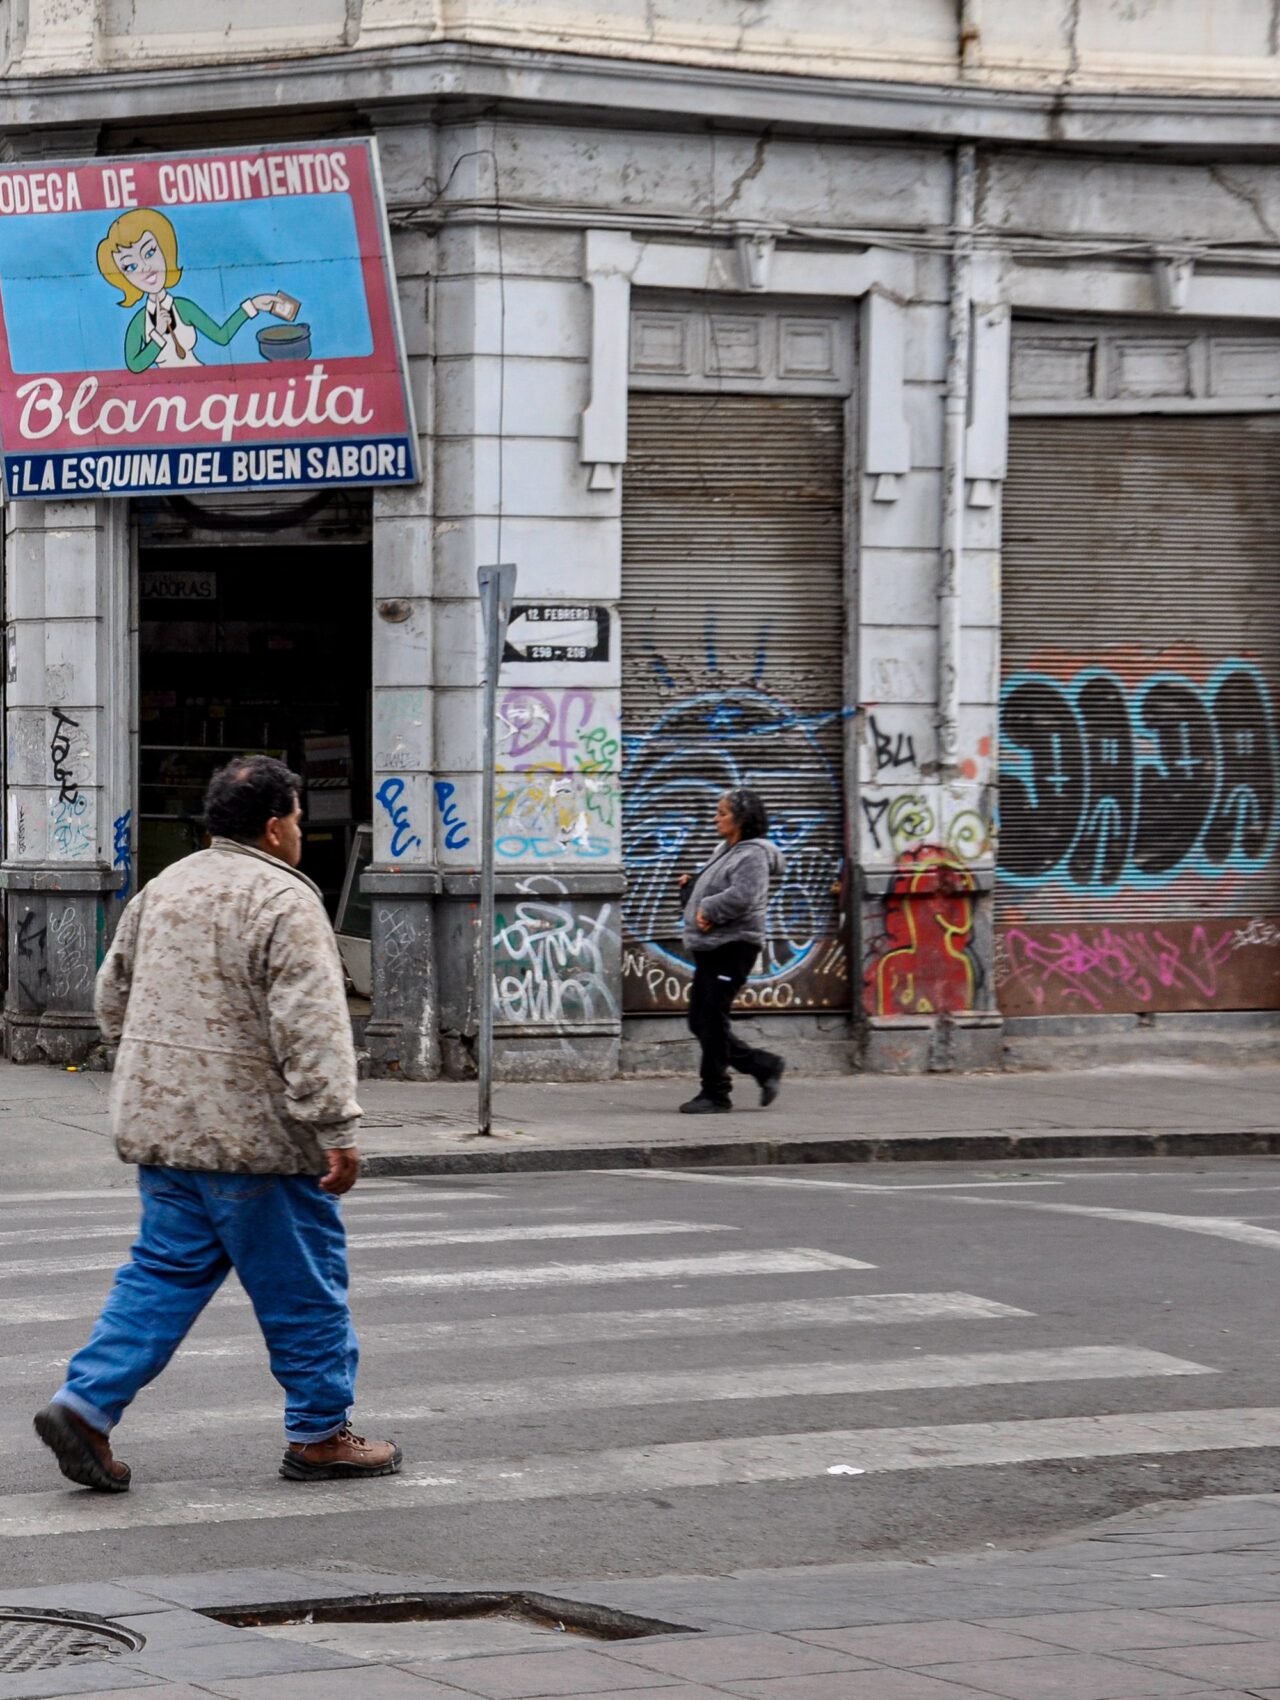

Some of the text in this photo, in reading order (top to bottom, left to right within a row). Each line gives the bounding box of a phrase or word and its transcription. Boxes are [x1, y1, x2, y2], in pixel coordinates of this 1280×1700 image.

[102, 168, 138, 208] DE
[159, 152, 351, 205] CONDIMENTOS
[17, 364, 374, 442] Blanquita
[11, 444, 407, 495] ¡LA ESQUINA DEL BUEN SABOR!
[527, 608, 590, 620] 12 FEBRERO
